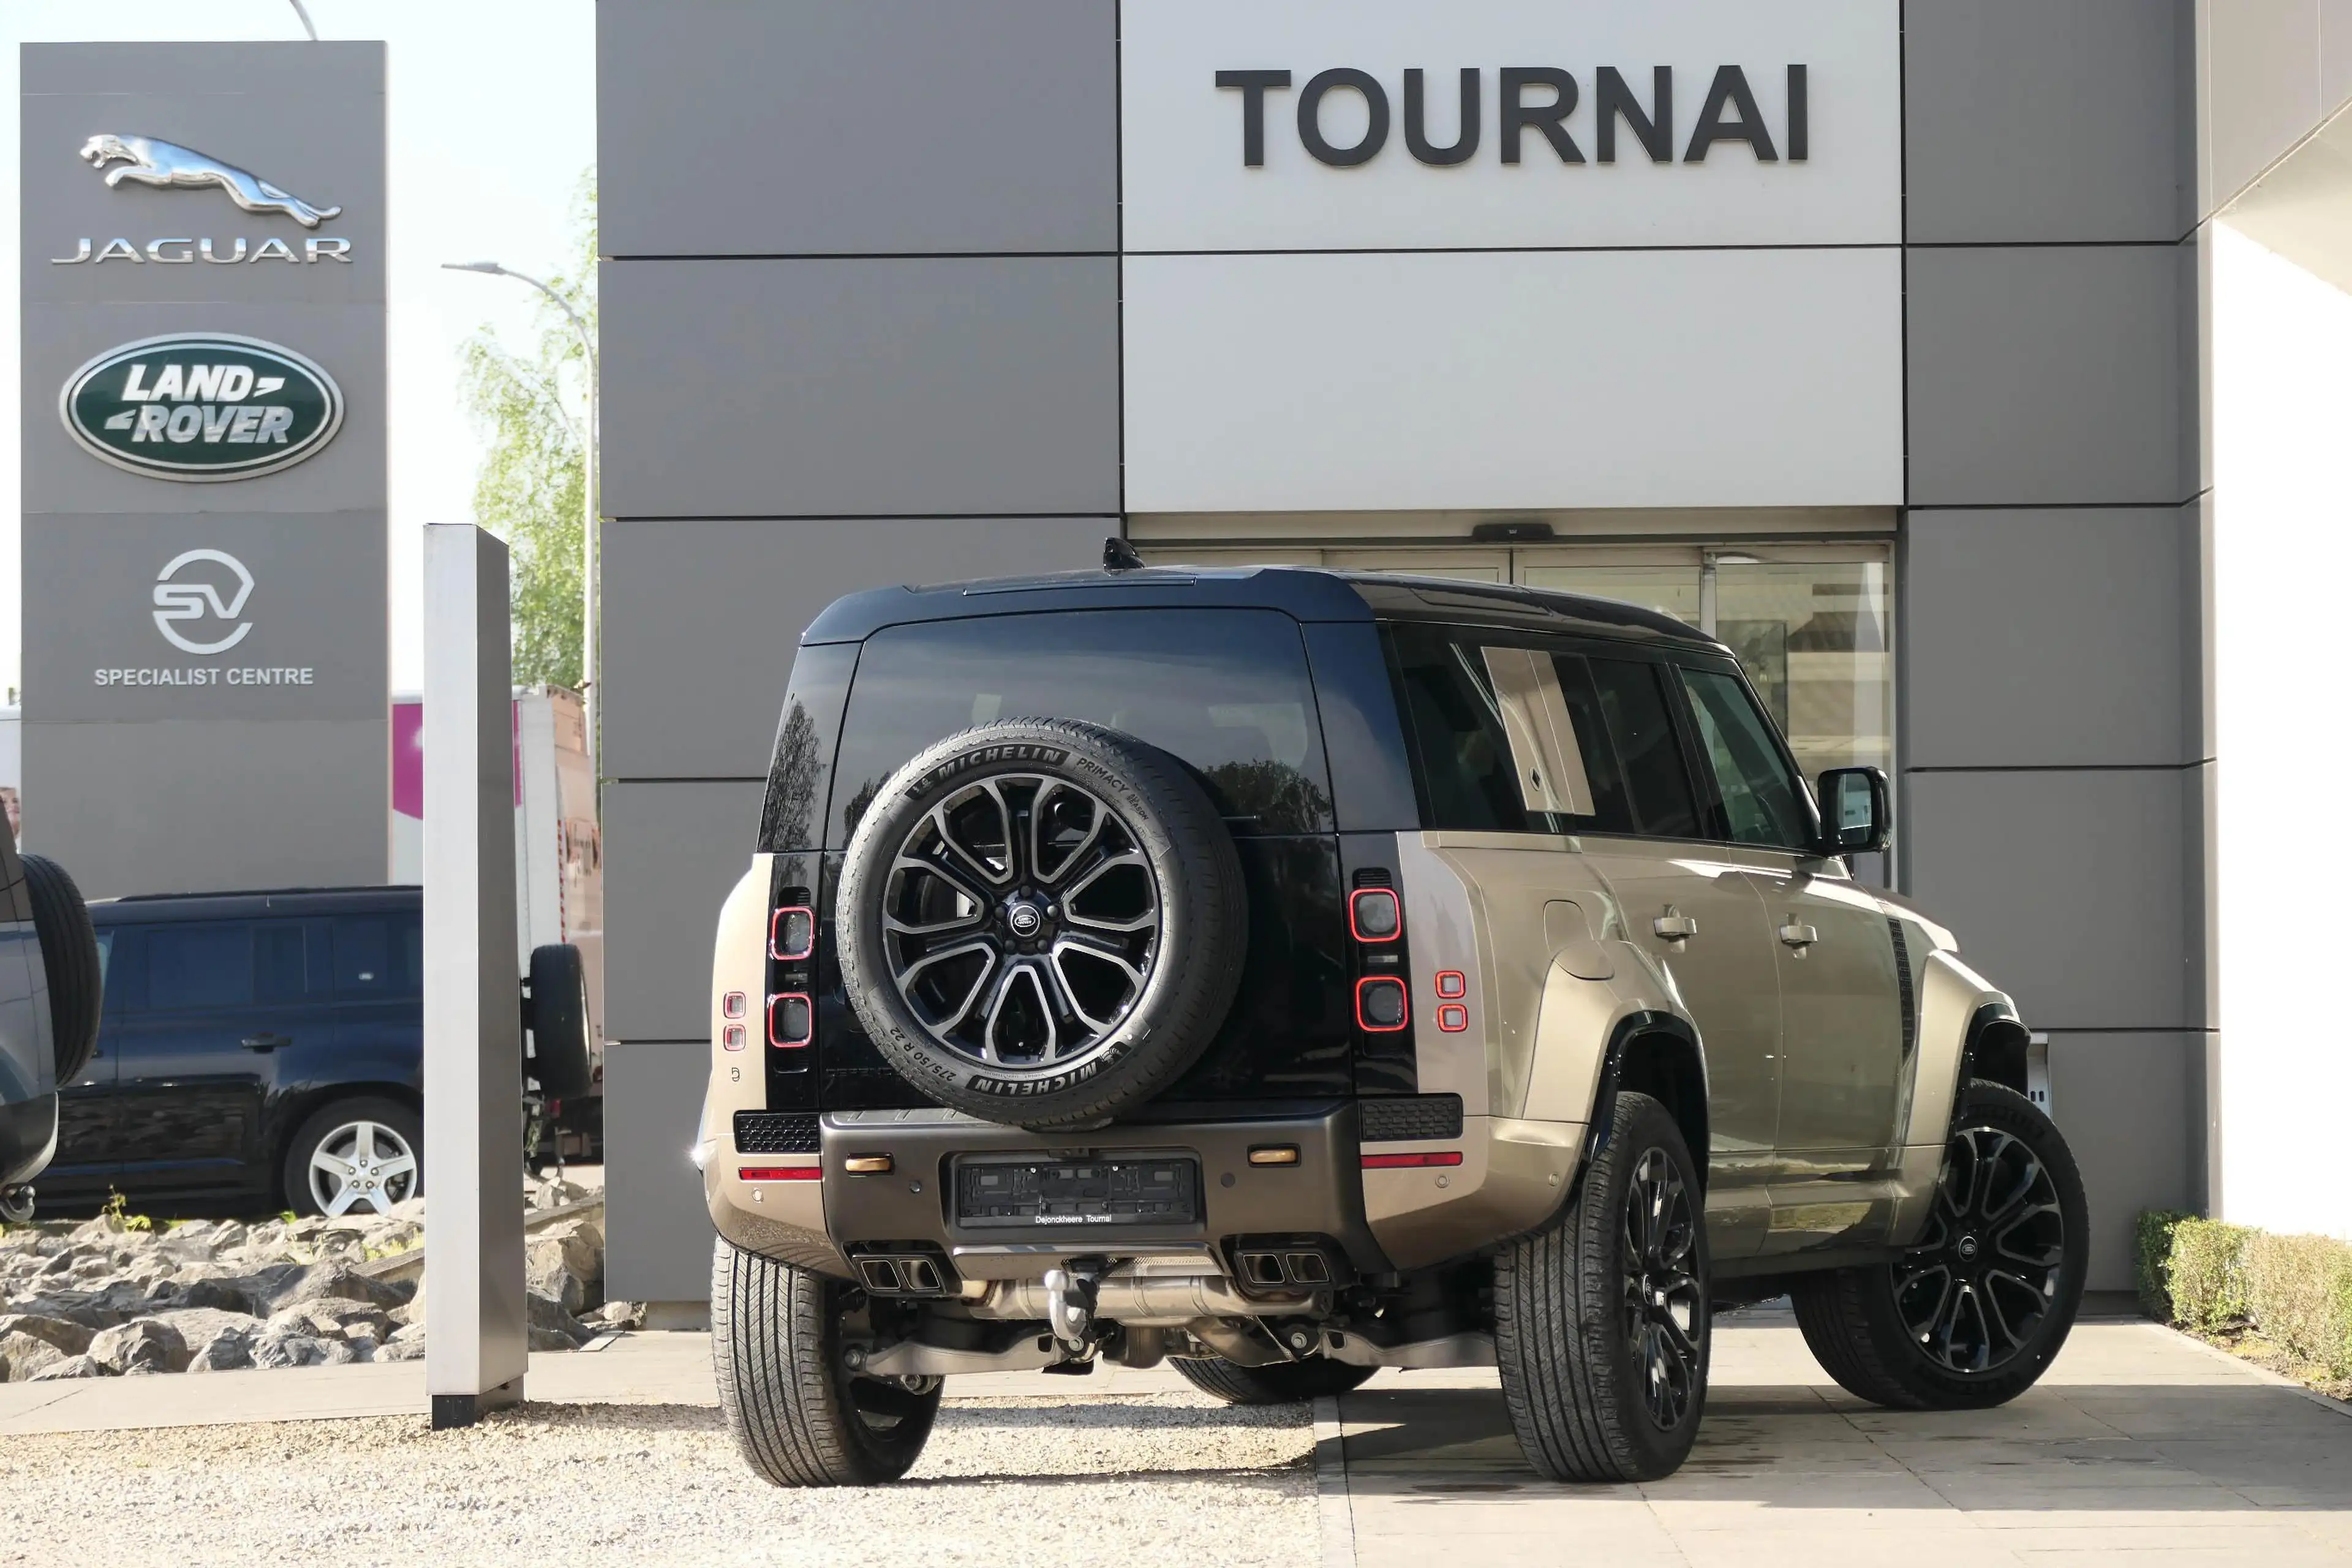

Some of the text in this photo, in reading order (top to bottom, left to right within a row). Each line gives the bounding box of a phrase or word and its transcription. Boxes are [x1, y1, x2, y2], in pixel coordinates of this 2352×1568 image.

[1215, 64, 1808, 168] TOURNAI
[51, 238, 353, 264] JAGUAR
[121, 364, 254, 402] LAND
[131, 405, 294, 443] ROVER
[94, 668, 314, 686] SPECIALIST CENTRE
[938, 746, 1061, 780] MICHELIN
[1076, 757, 1130, 793] PRIMACY
[890, 1027, 957, 1082] 275/50 R 22
[975, 1061, 1097, 1095] MICHELIN
